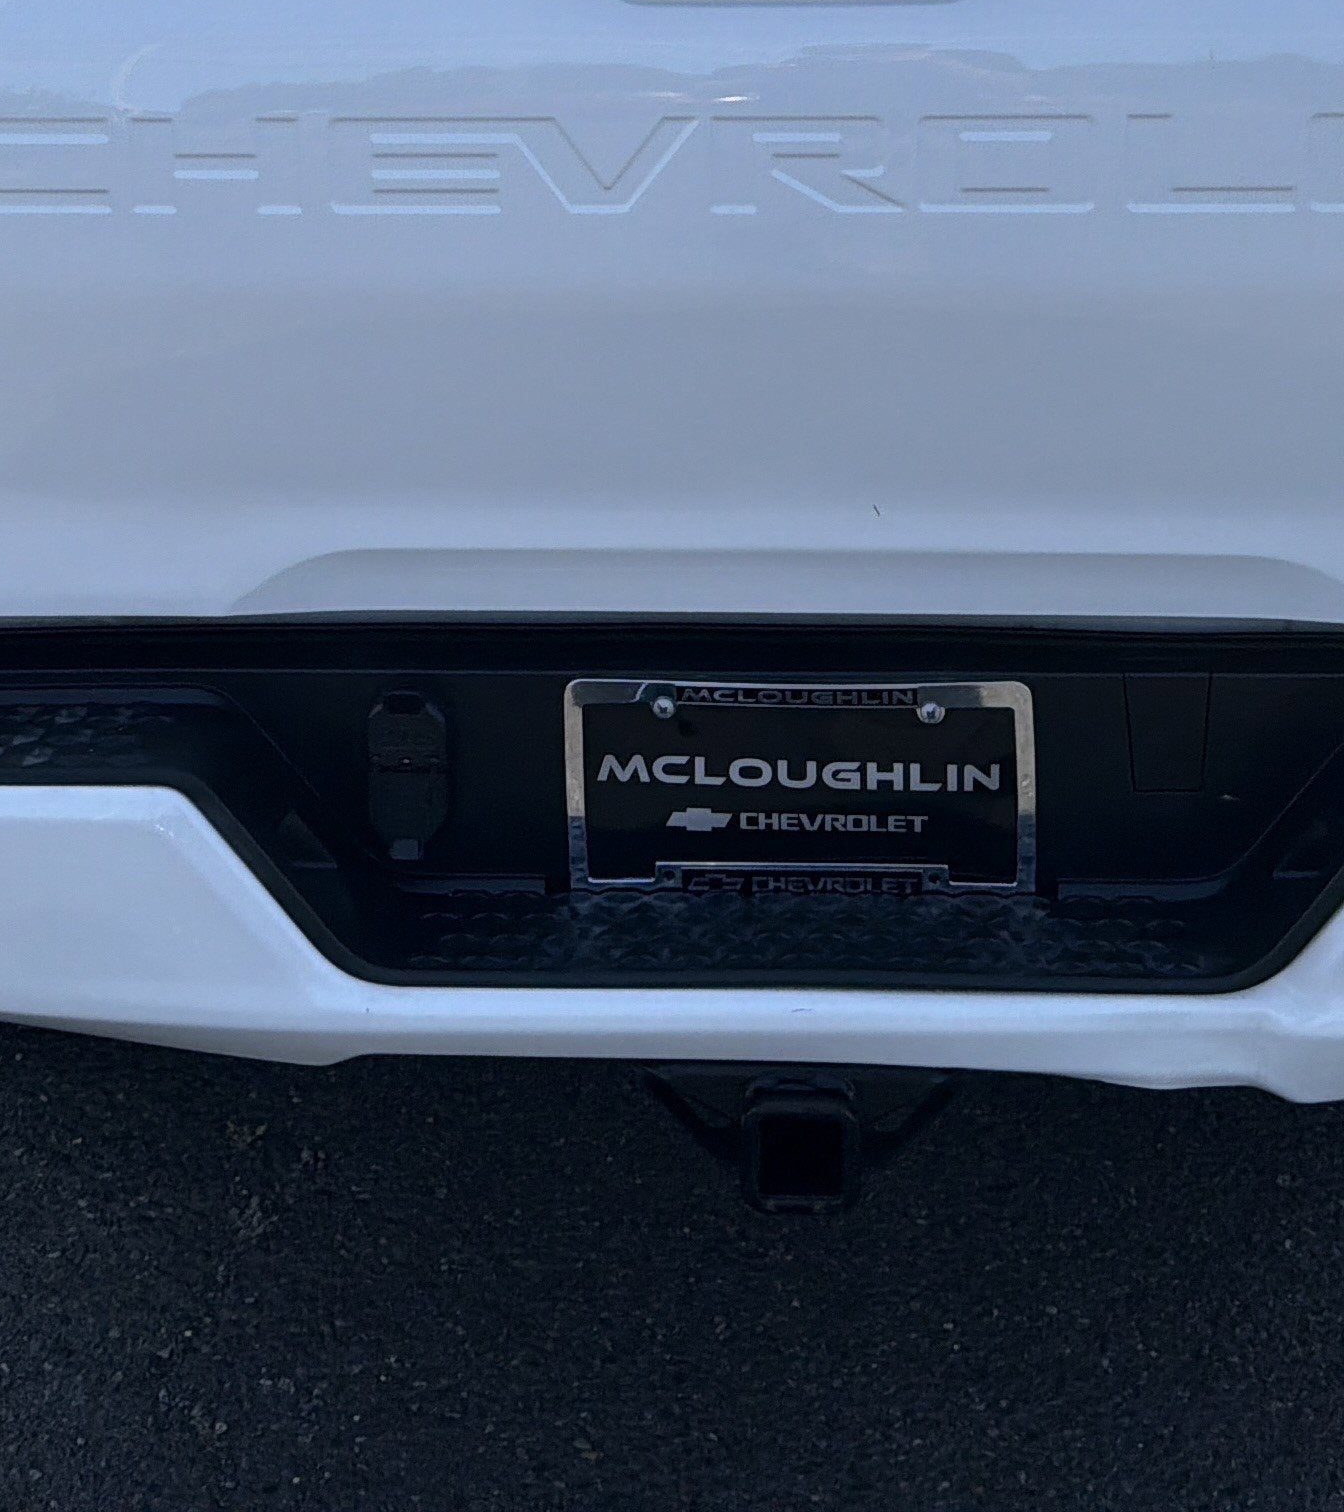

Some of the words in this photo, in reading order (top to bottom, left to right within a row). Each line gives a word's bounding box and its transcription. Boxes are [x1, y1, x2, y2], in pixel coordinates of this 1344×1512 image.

[680, 686, 915, 706] MCLOUGHLIN
[596, 753, 1001, 793] MCLOUGHLIN
[739, 811, 929, 833] CHEVROLET
[751, 875, 919, 894] CHEVROLET
